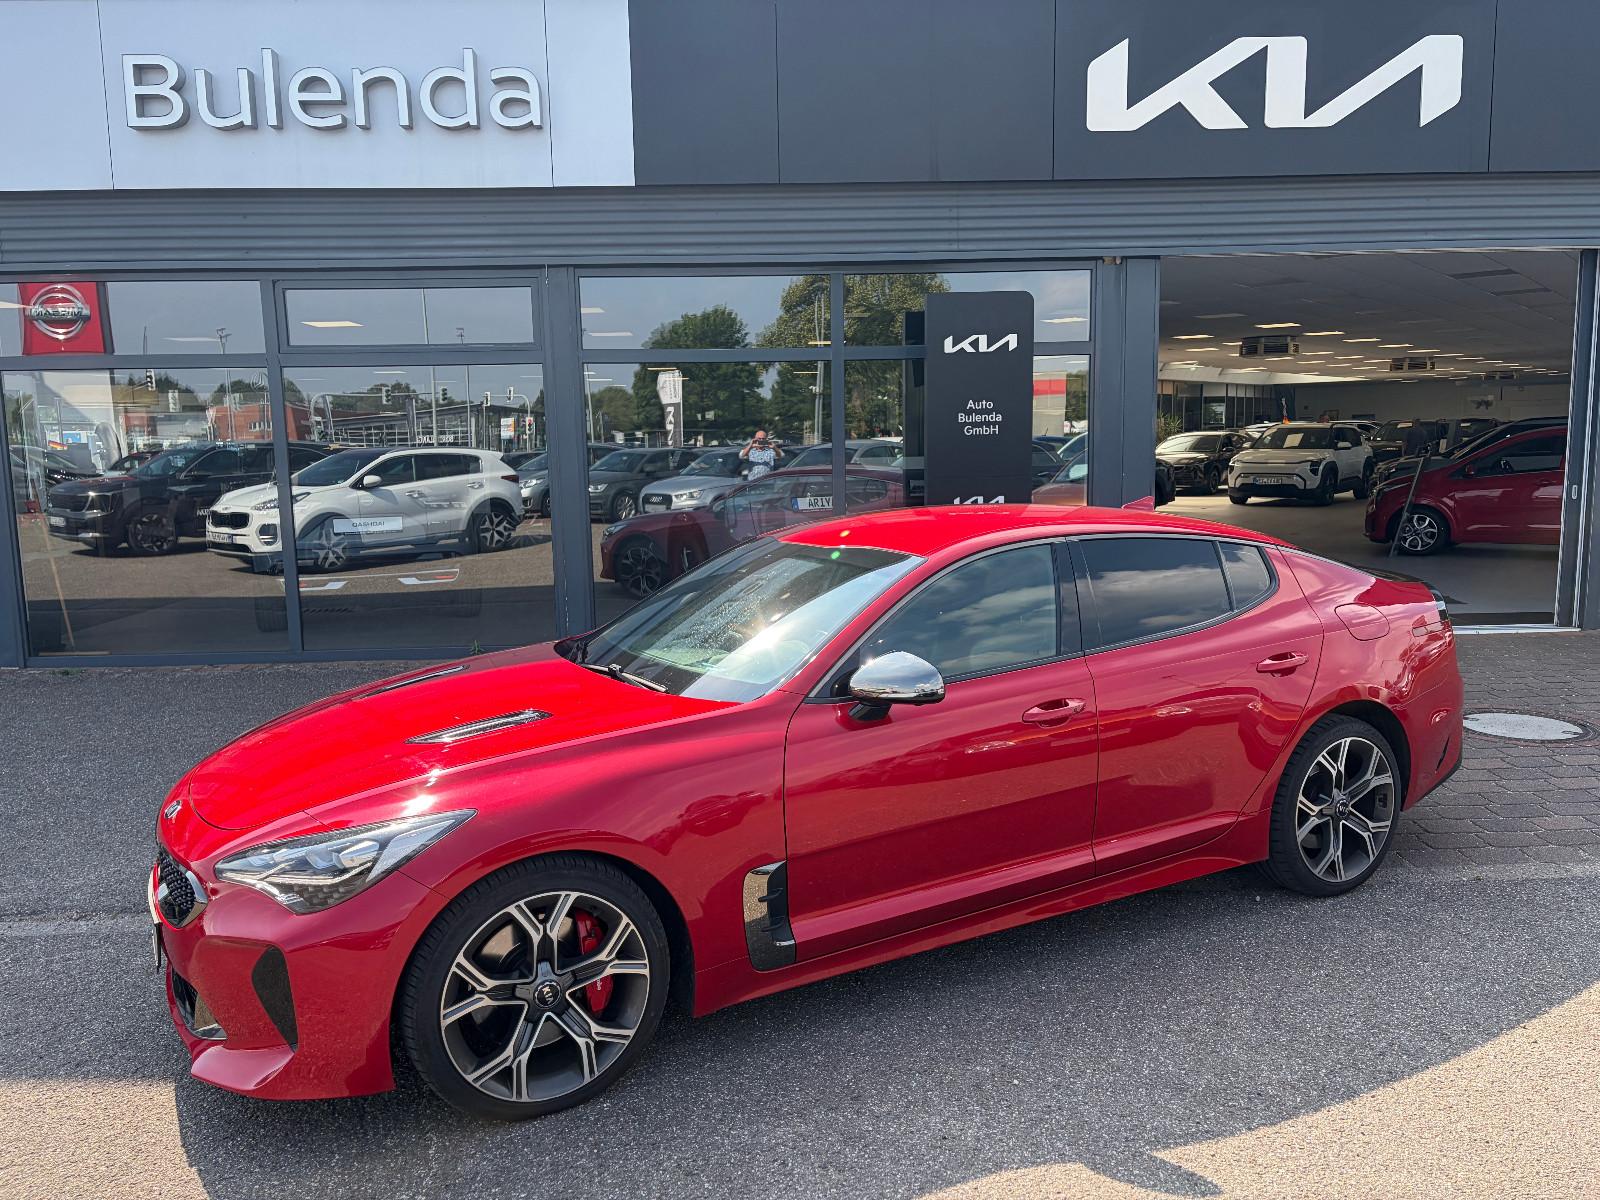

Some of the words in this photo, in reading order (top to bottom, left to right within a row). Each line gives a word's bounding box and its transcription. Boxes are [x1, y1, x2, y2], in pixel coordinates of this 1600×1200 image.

[121, 47, 543, 131] Bulenda
[1086, 34, 1464, 131] KIA
[943, 333, 1018, 354] KIA
[966, 399, 994, 410] Auto
[957, 411, 1003, 423] Bulenda
[963, 424, 999, 436] GmbH
[541, 985, 555, 1005] KIA
